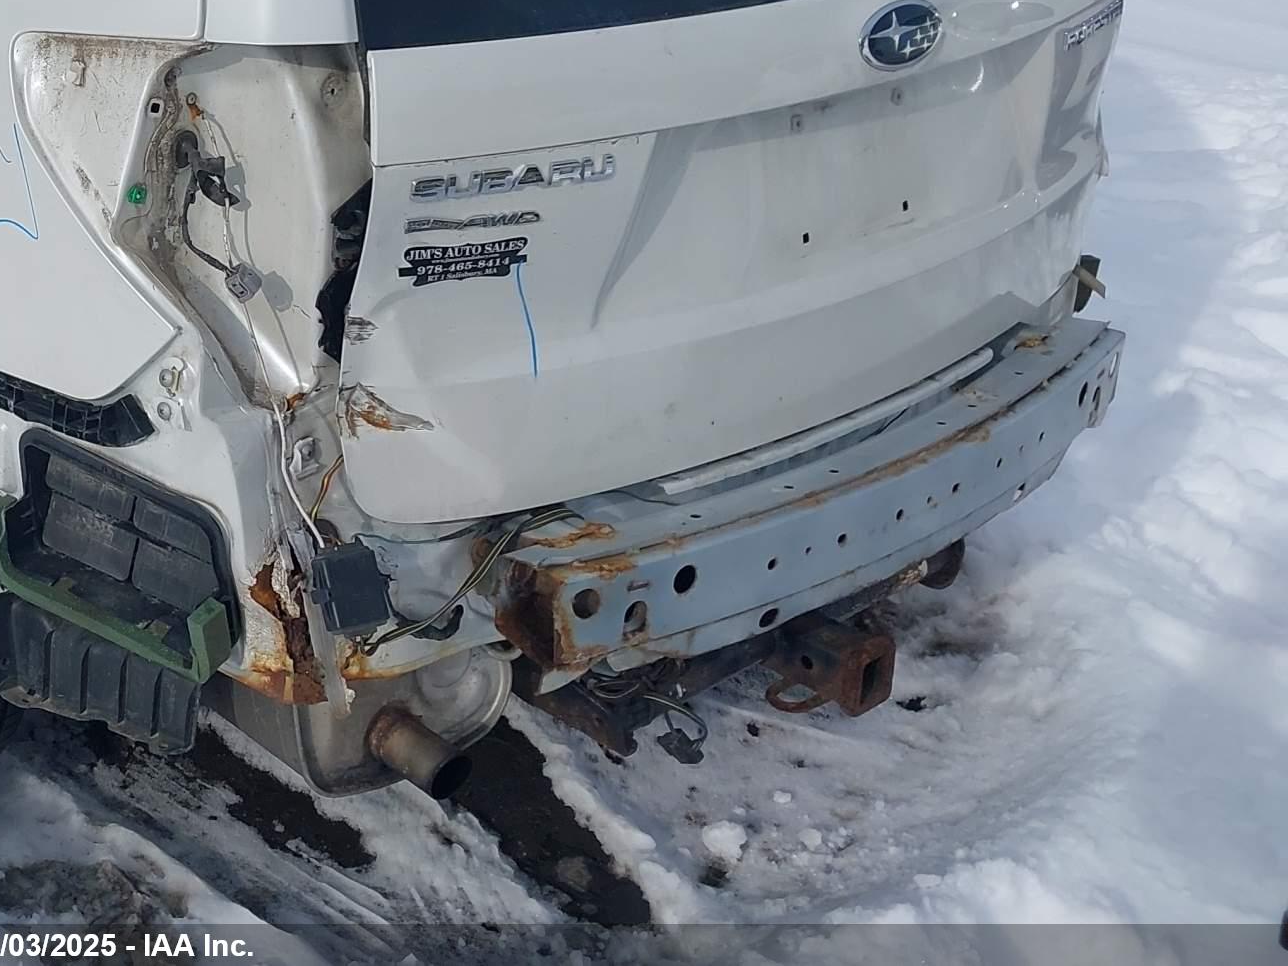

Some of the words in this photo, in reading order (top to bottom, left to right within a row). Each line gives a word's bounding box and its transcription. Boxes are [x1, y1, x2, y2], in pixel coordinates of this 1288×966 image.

[410, 153, 617, 203] SUBARU
[406, 248, 443, 260] JIM'S
[445, 245, 481, 258] AUTO
[484, 239, 525, 253] SALES
[416, 256, 510, 275] 978-465-8414
